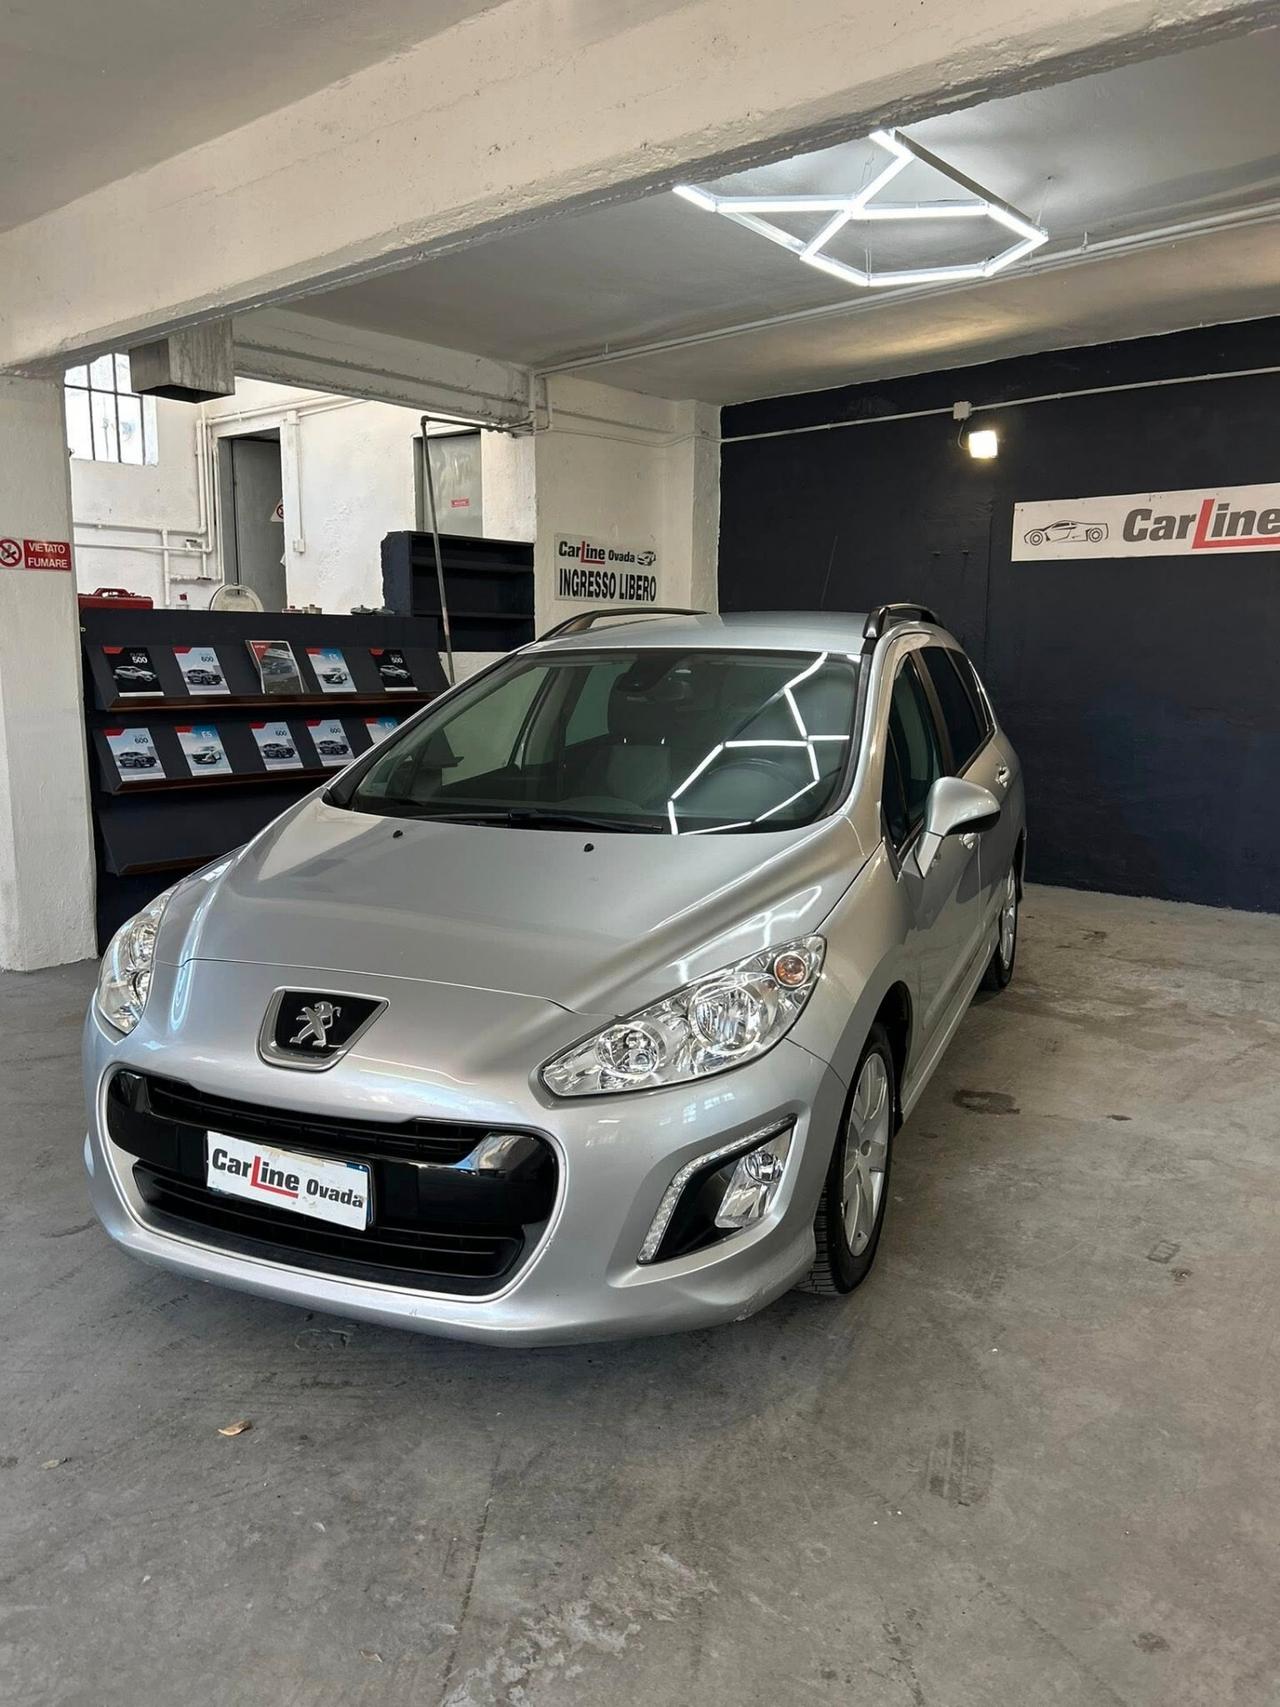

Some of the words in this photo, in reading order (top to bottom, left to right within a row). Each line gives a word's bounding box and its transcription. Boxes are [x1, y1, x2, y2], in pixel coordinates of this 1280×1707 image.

[1123, 498, 1280, 549] CarLine
[28, 542, 66, 554] VIETATO
[558, 541, 605, 565] CarLine
[608, 549, 636, 563] Ovada
[27, 557, 69, 568] FUMARE
[559, 568, 617, 599] INGRESSO
[619, 573, 657, 602] LIBERO
[131, 656, 148, 664] 500
[212, 1148, 300, 1199] CarLine
[306, 1178, 364, 1209] Ovada
